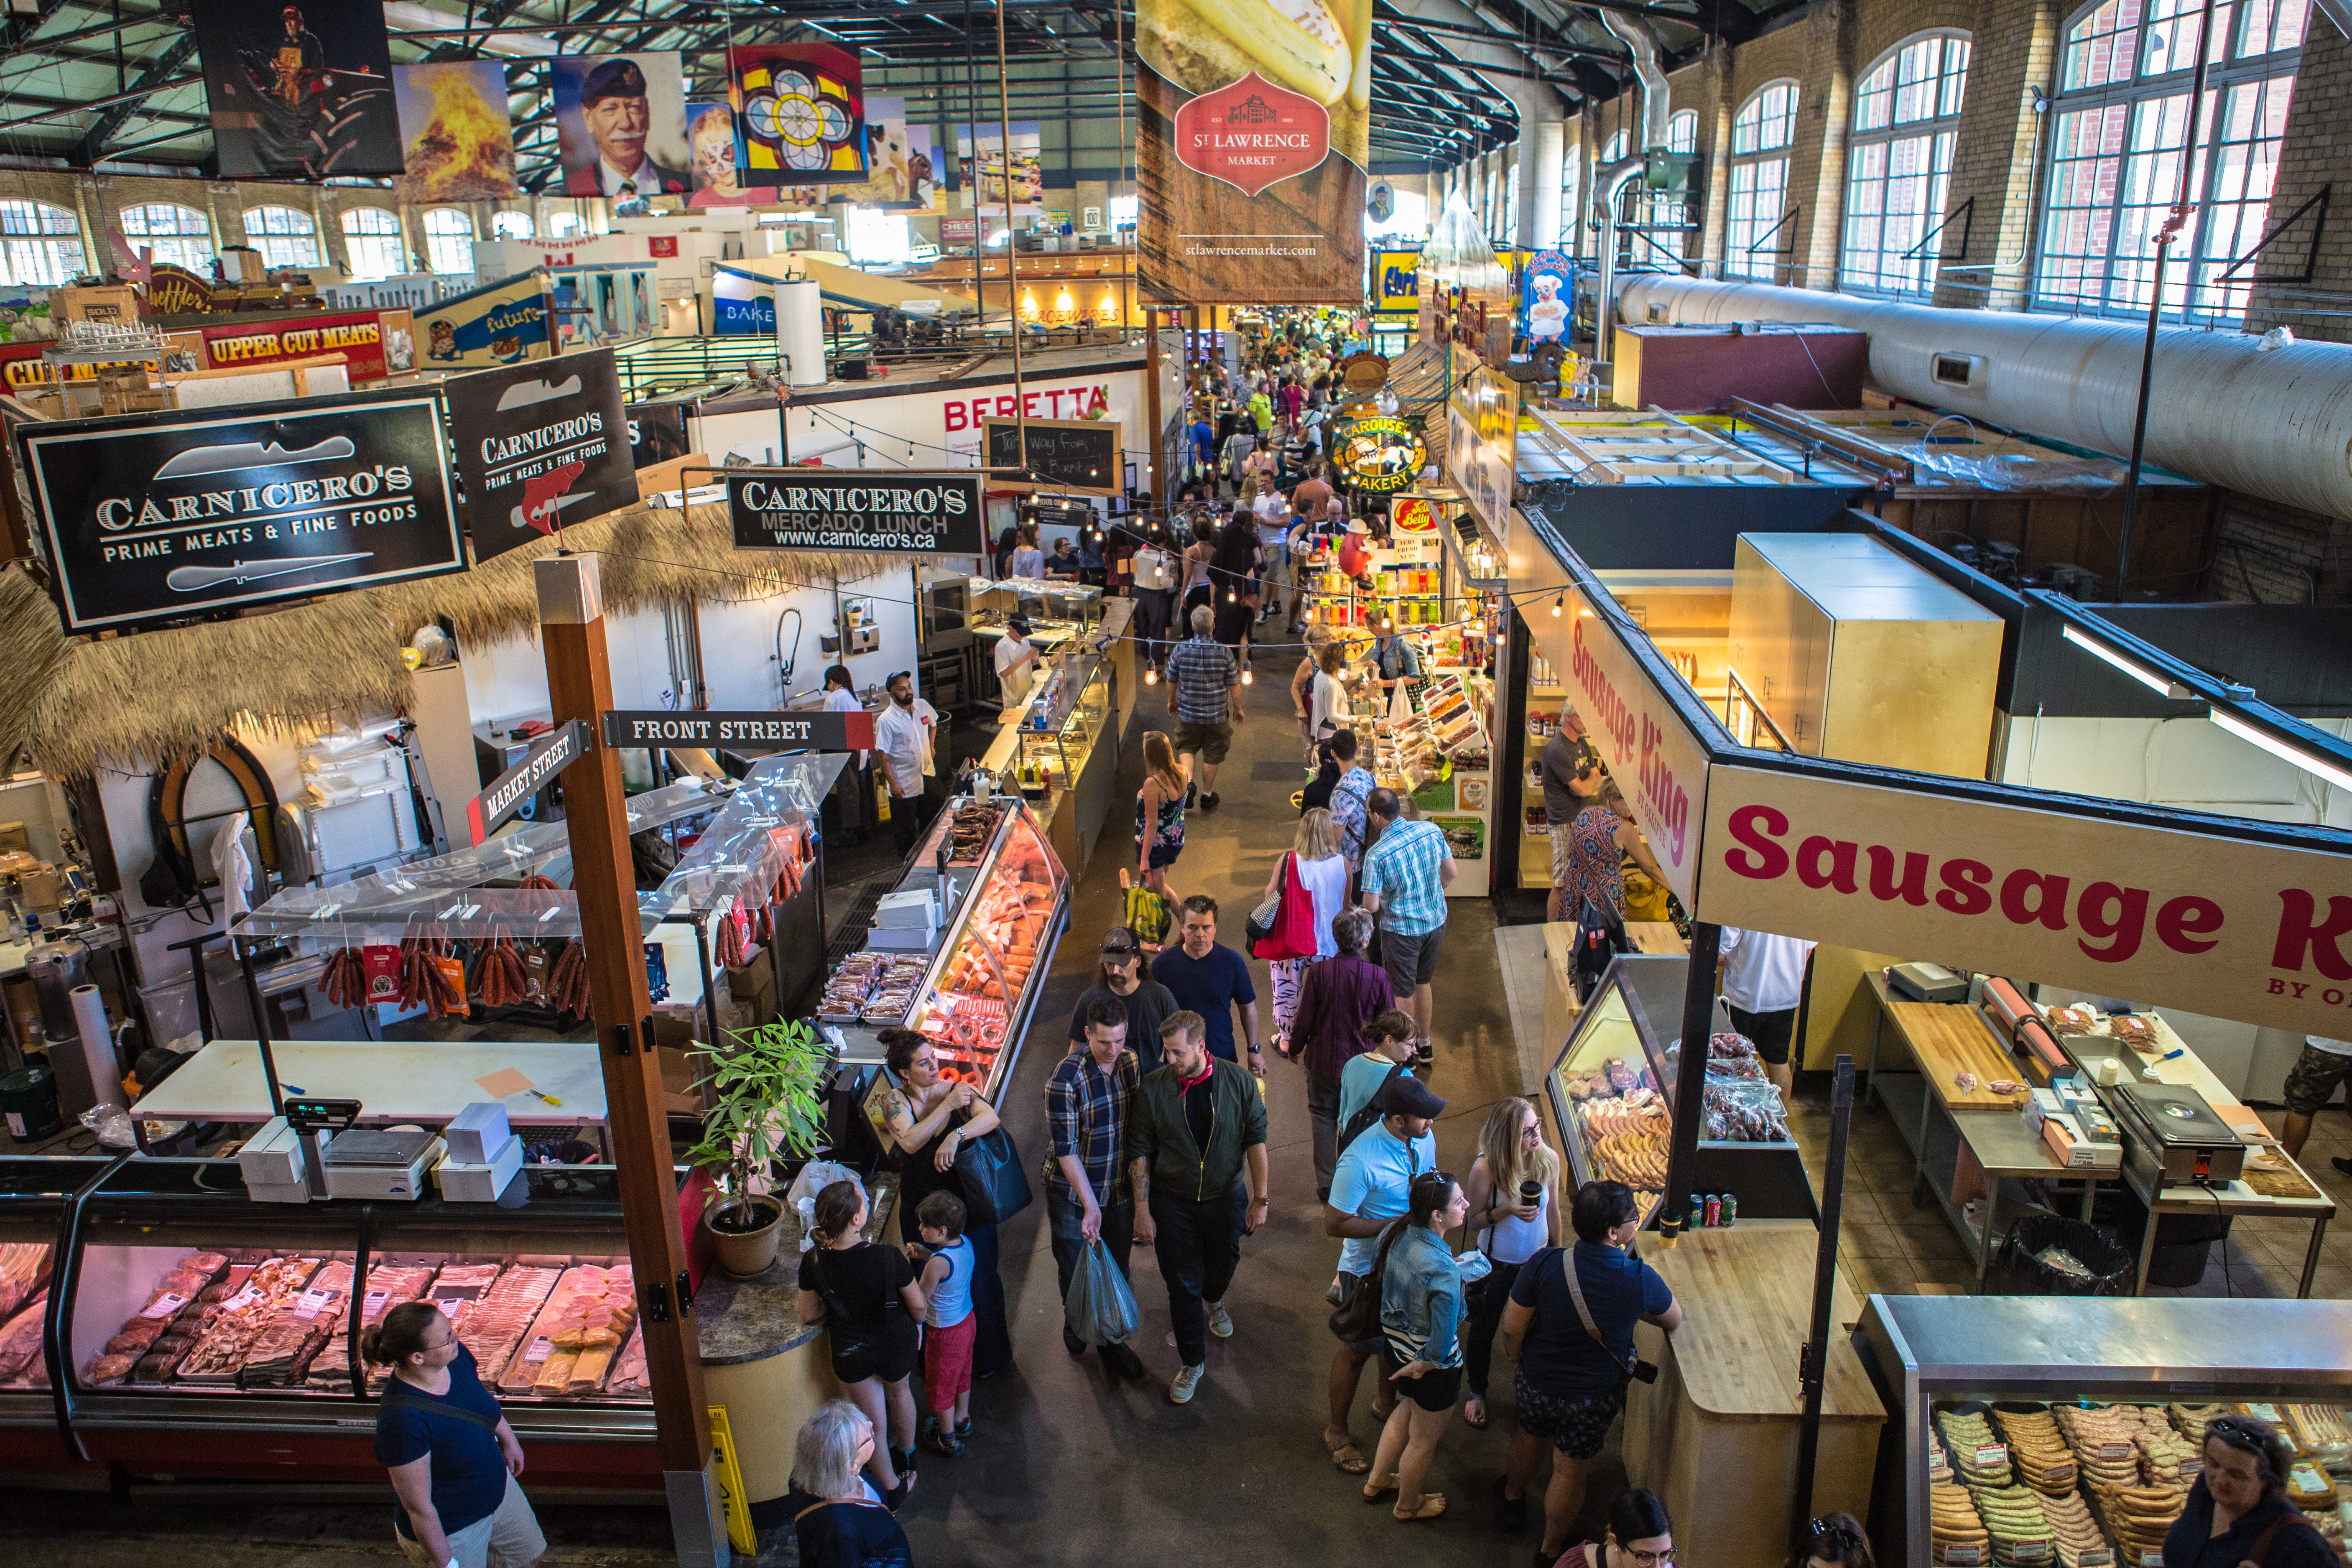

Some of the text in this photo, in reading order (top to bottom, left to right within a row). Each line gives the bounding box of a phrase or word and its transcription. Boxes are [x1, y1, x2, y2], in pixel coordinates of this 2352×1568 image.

[1214, 134, 1310, 148] LAWRENCE
[1227, 156, 1277, 165] MARKET
[1185, 243, 1316, 256] stlawrencemarket.com
[87, 308, 117, 316] SOLO
[211, 322, 380, 362] UPPER CUT MEATS
[944, 385, 1108, 432] BERETTA
[481, 412, 602, 464] CARNICERO'S
[485, 443, 607, 491] PRIME MEATS & FINE FOODS
[97, 465, 412, 530] CARNICERO'S
[742, 482, 967, 514] CARNICERO'S
[104, 504, 417, 562] PRIME MEATS & FINE FOODS
[761, 512, 948, 535] MERCADO LUNCH
[775, 529, 935, 548] www.carnicero's.ca
[1403, 513, 1430, 531] Belly
[633, 721, 811, 739] FRONT STREET
[1573, 618, 1688, 867] Sausage King
[487, 734, 569, 821] MARKET STREET
[1638, 789, 1666, 849] BY OLLIFFE
[1724, 804, 2224, 962] Sausage
[2268, 978, 2310, 999] BY
